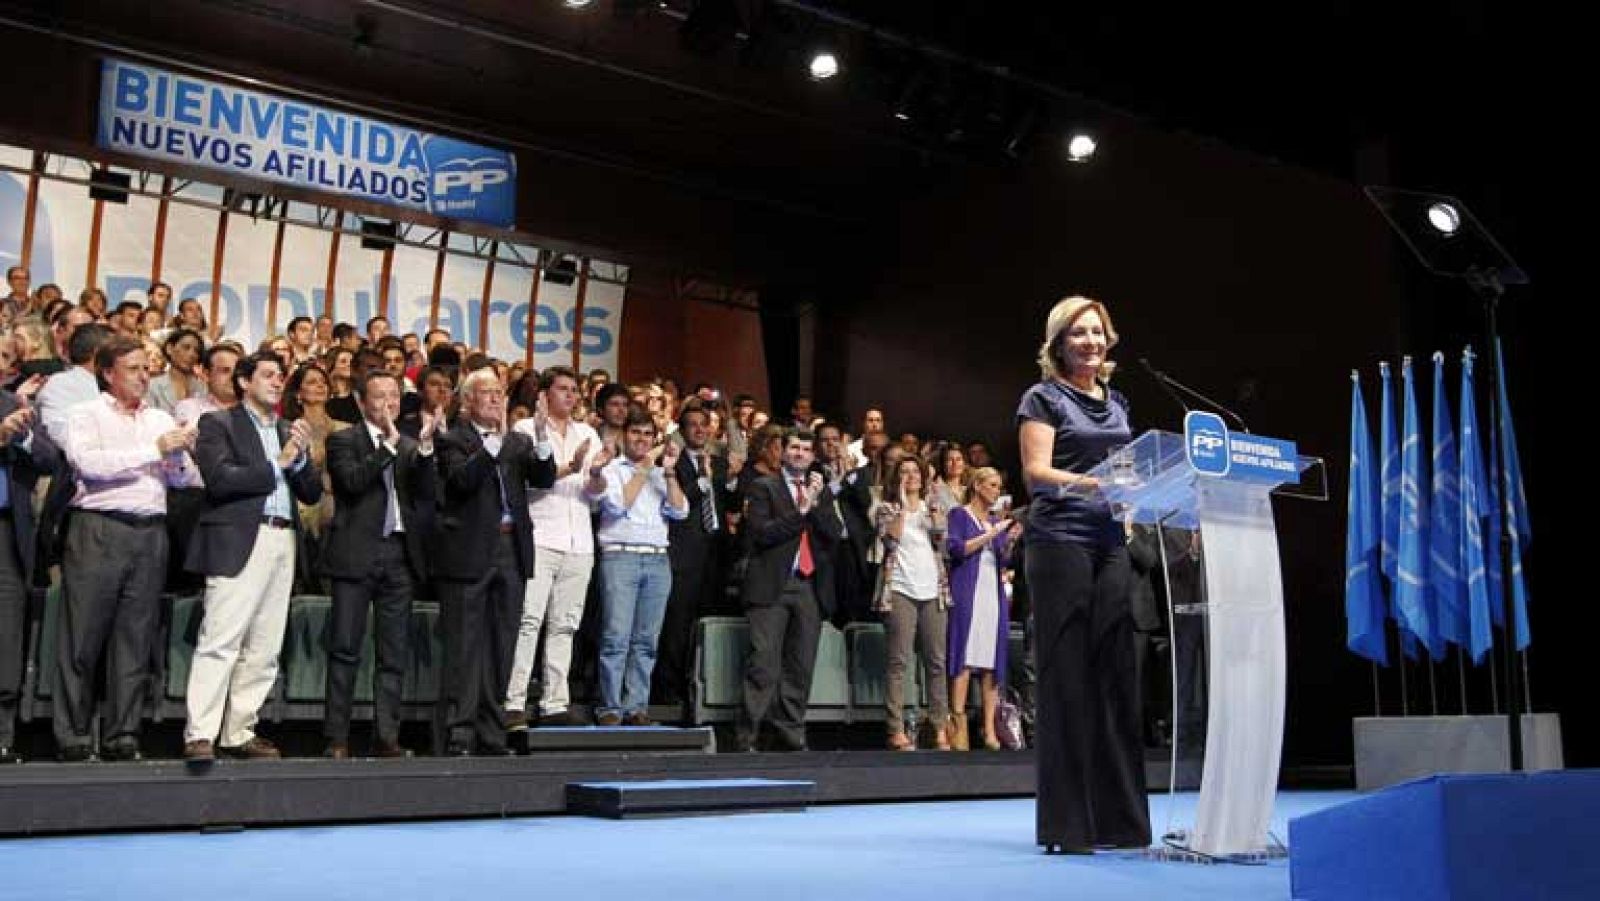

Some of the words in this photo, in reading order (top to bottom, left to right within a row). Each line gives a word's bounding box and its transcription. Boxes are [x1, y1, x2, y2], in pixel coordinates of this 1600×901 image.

[115, 66, 426, 172] BIENVENIDA
[112, 116, 253, 168] NUEVOS
[262, 149, 427, 202] AFILIADOS
[433, 169, 509, 195] PP
[1193, 434, 1224, 450] PP
